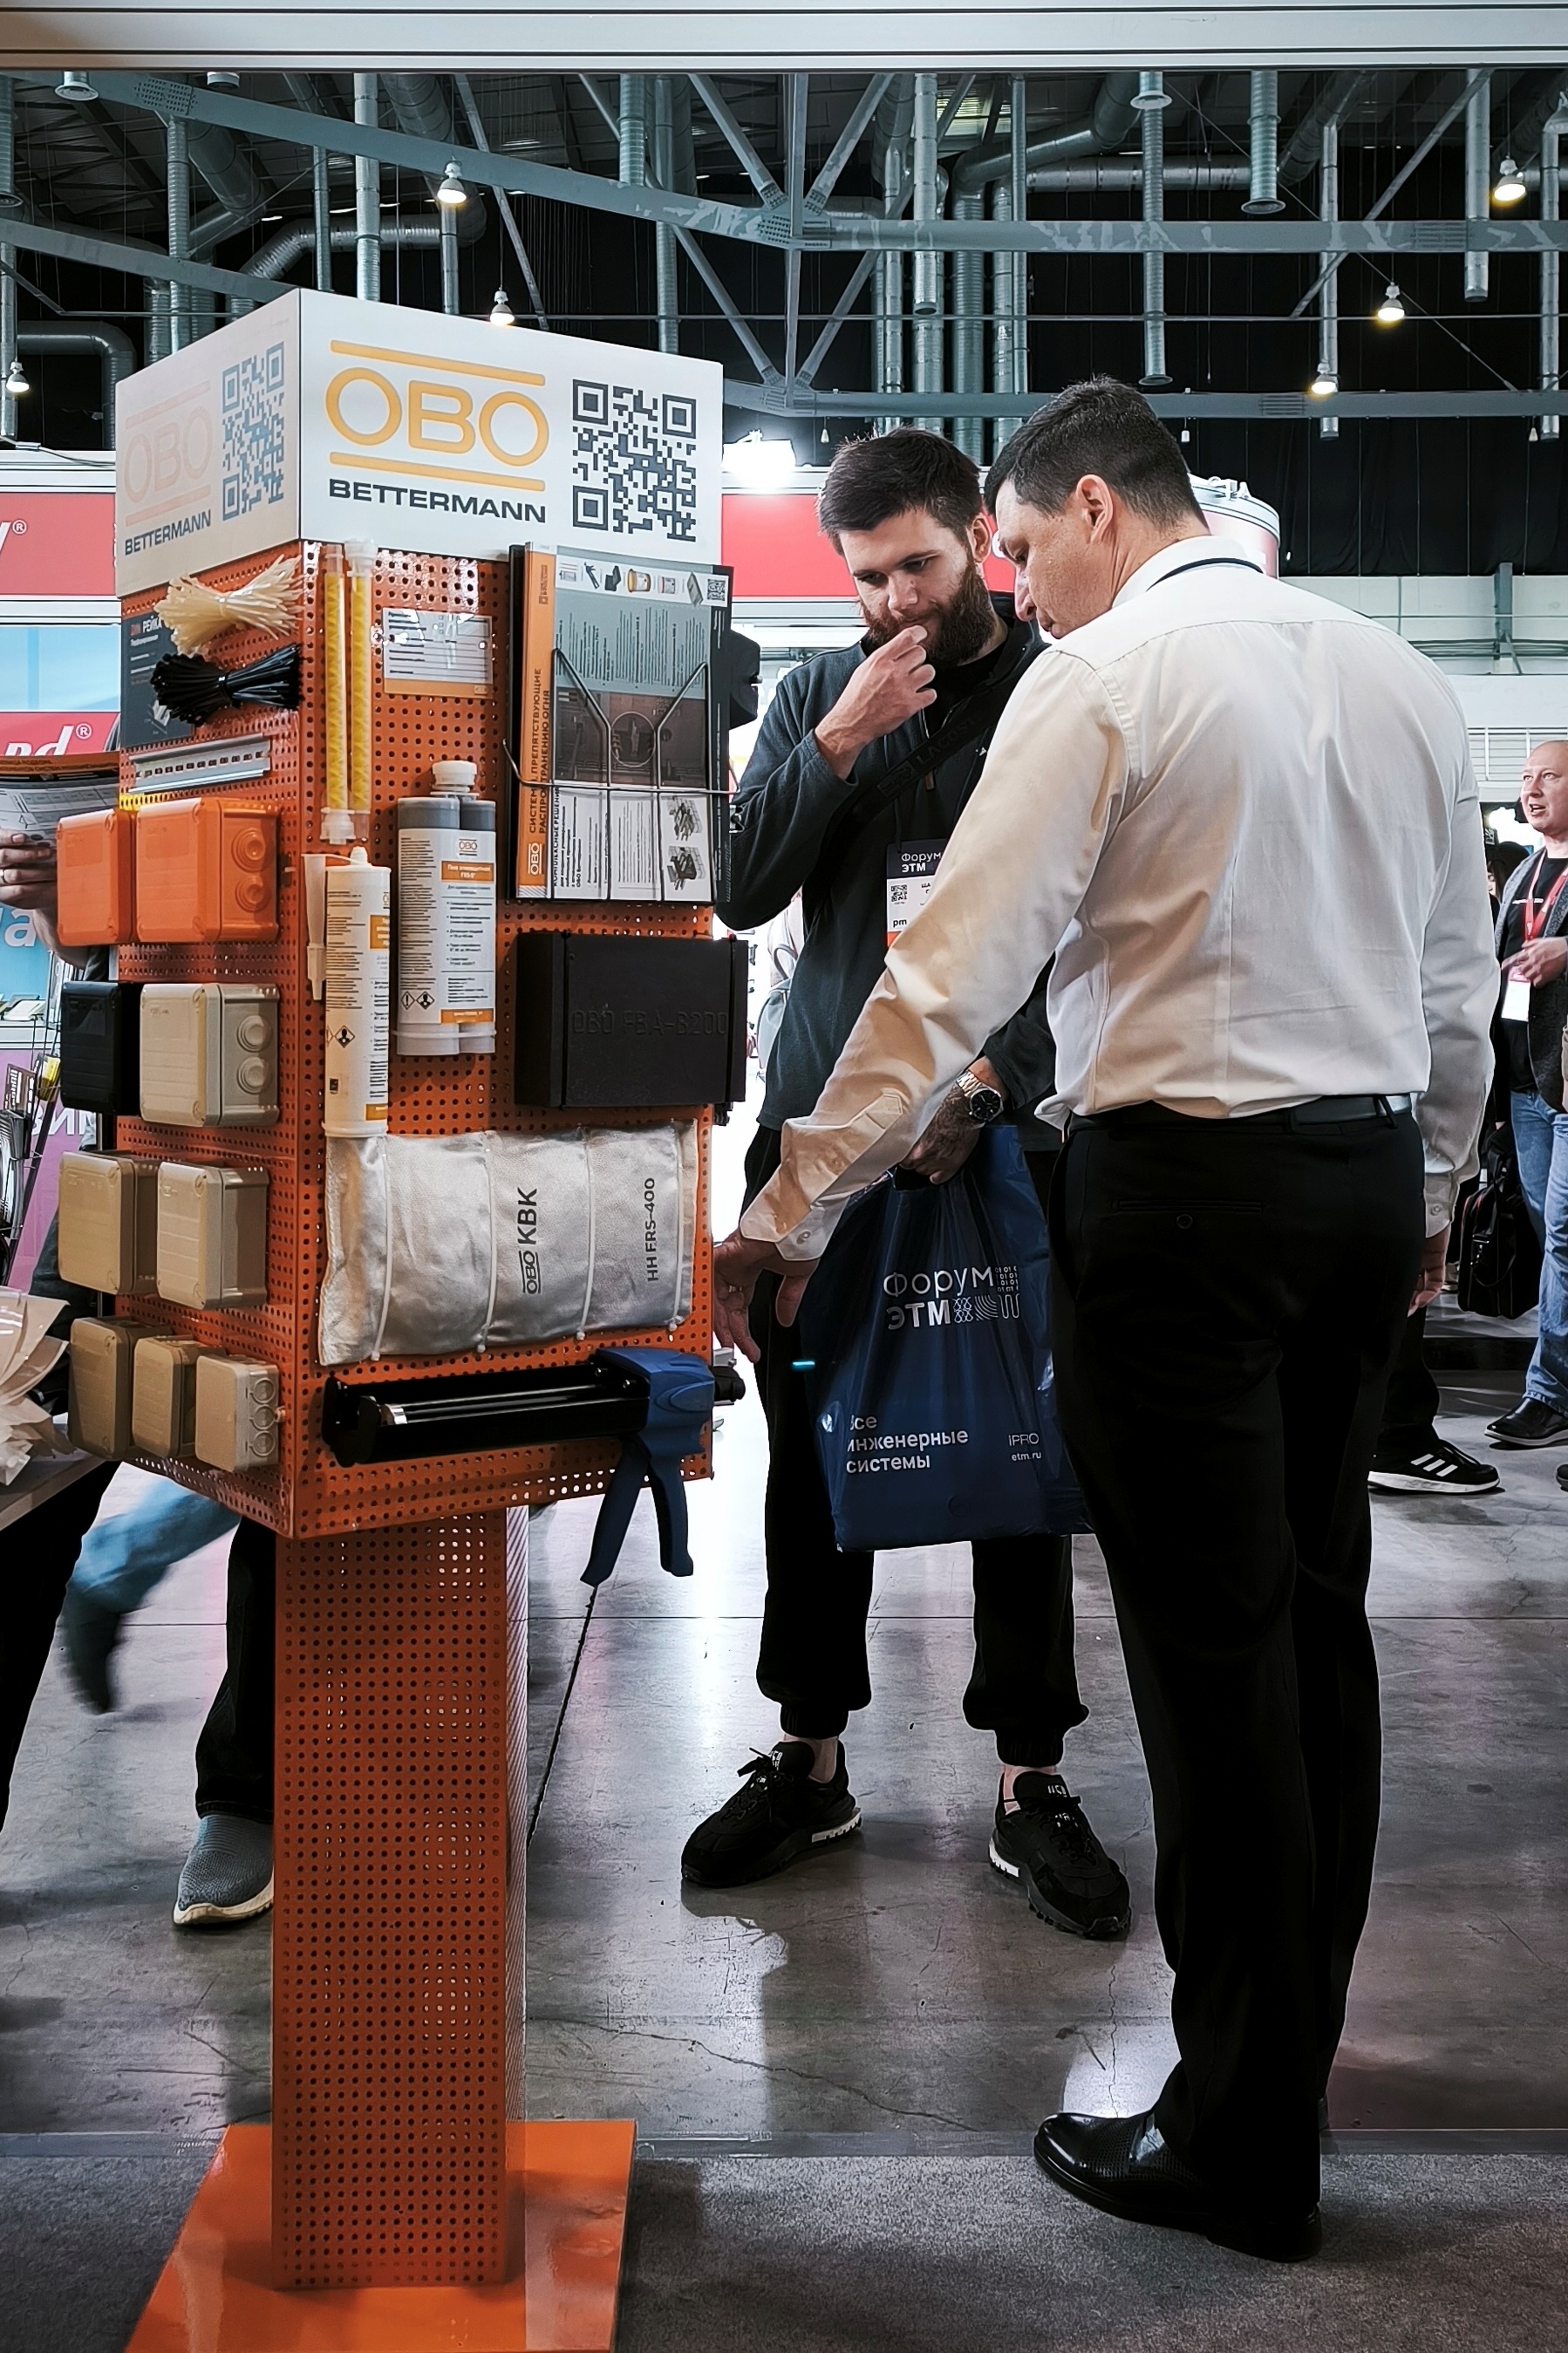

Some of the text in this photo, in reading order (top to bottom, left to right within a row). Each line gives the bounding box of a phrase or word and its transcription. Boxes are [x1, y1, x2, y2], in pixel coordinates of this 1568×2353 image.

[325, 368, 550, 467] OBO
[124, 404, 214, 504] OBO
[329, 477, 547, 524] BETTERMANN
[124, 509, 212, 556] BETTERMANN
[539, 722, 550, 834] РАСПРОТРАНЕНИЮ
[528, 776, 539, 834] СИСТЕМ,
[530, 842, 540, 876] OBO
[901, 852, 942, 863] Форум
[901, 863, 926, 873] ЭТМ
[572, 1009, 614, 1034] OBO
[517, 1187, 538, 1294] OBO KBK
[883, 1265, 994, 1298] Форум
[886, 1299, 951, 1330] ЭТМ
[847, 1429, 969, 1452] инженерные
[1011, 1451, 1042, 1462] etm.ru
[846, 1455, 931, 1474] системы
